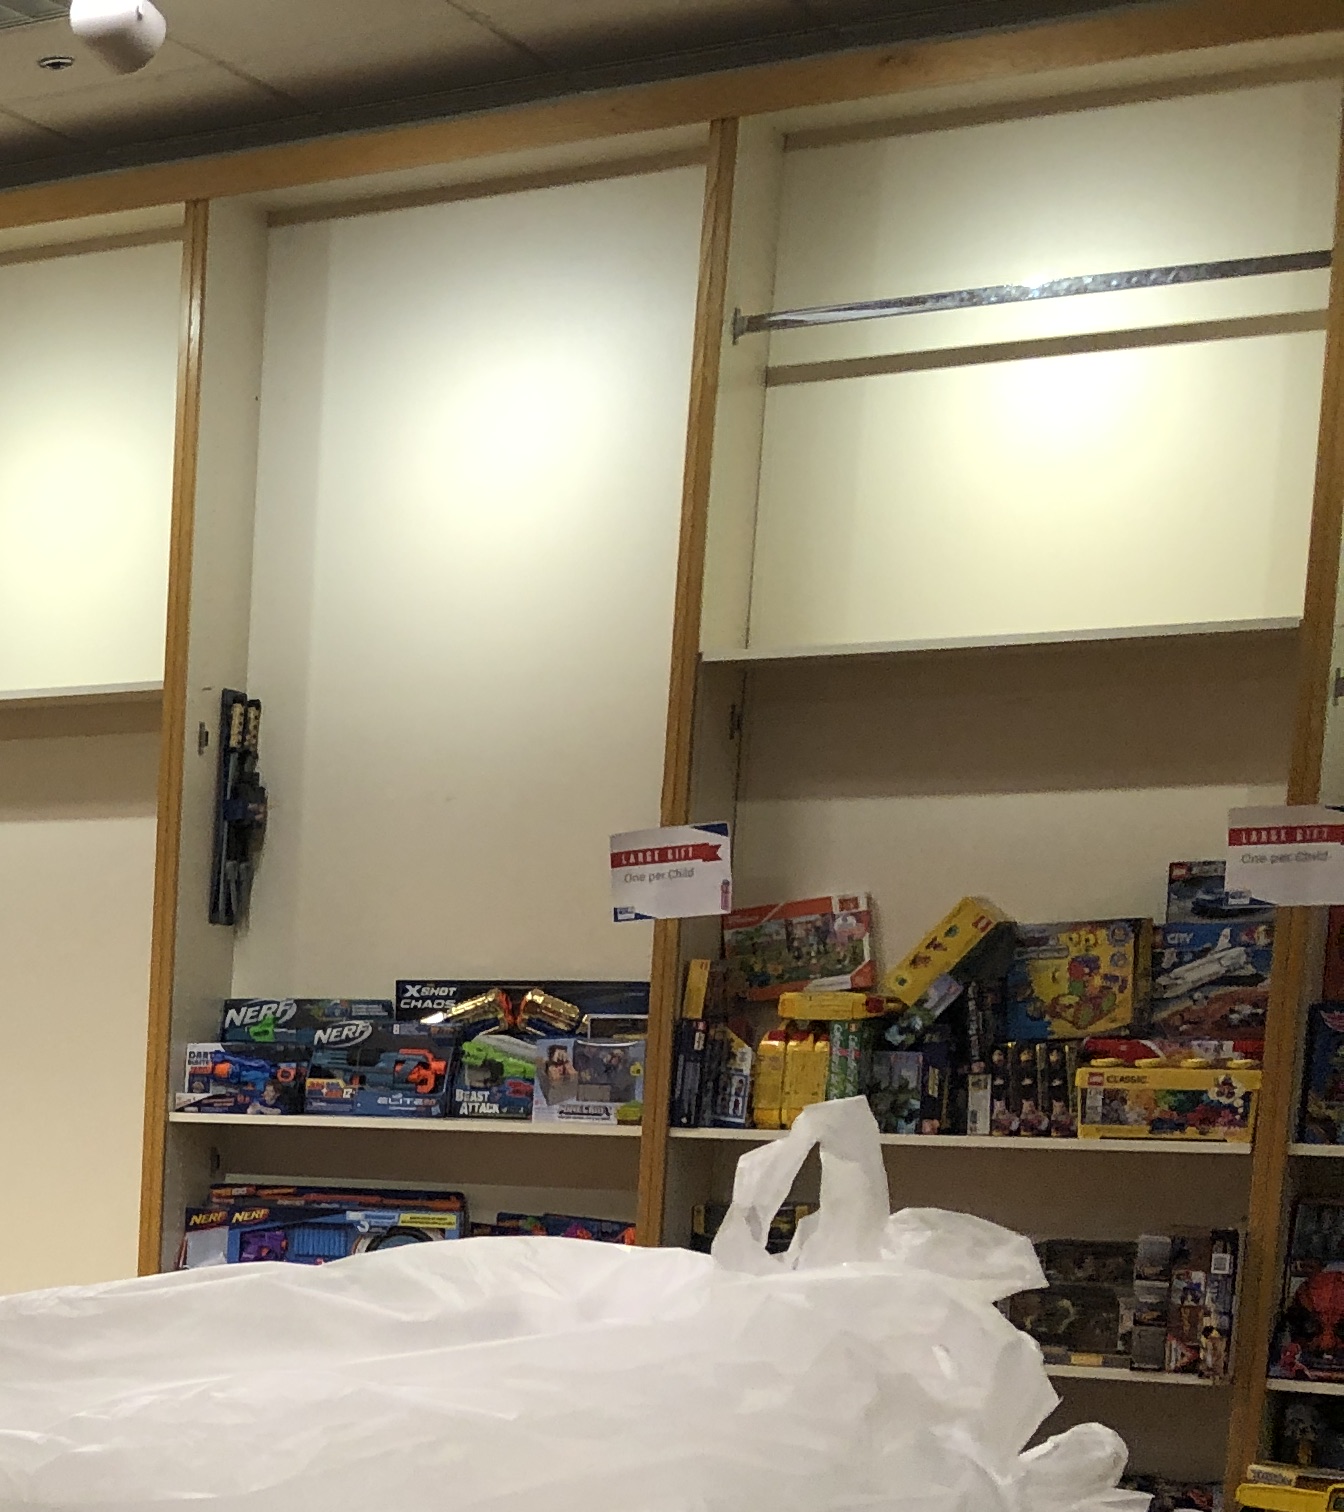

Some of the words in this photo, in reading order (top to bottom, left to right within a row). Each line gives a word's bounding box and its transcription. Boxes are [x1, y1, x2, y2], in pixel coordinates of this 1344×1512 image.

[621, 850, 660, 864] LARGE
[667, 847, 693, 859] GIFT
[624, 872, 645, 883] One
[649, 871, 665, 883] per
[668, 867, 694, 879] Child
[400, 999, 457, 1009] CHAOS
[225, 999, 296, 1029] NERF
[314, 1022, 370, 1047] NERF
[455, 1089, 490, 1102] BEAST
[459, 1101, 499, 1115] ATTACK
[189, 1211, 226, 1226] NERF
[232, 1209, 269, 1223] NERF
